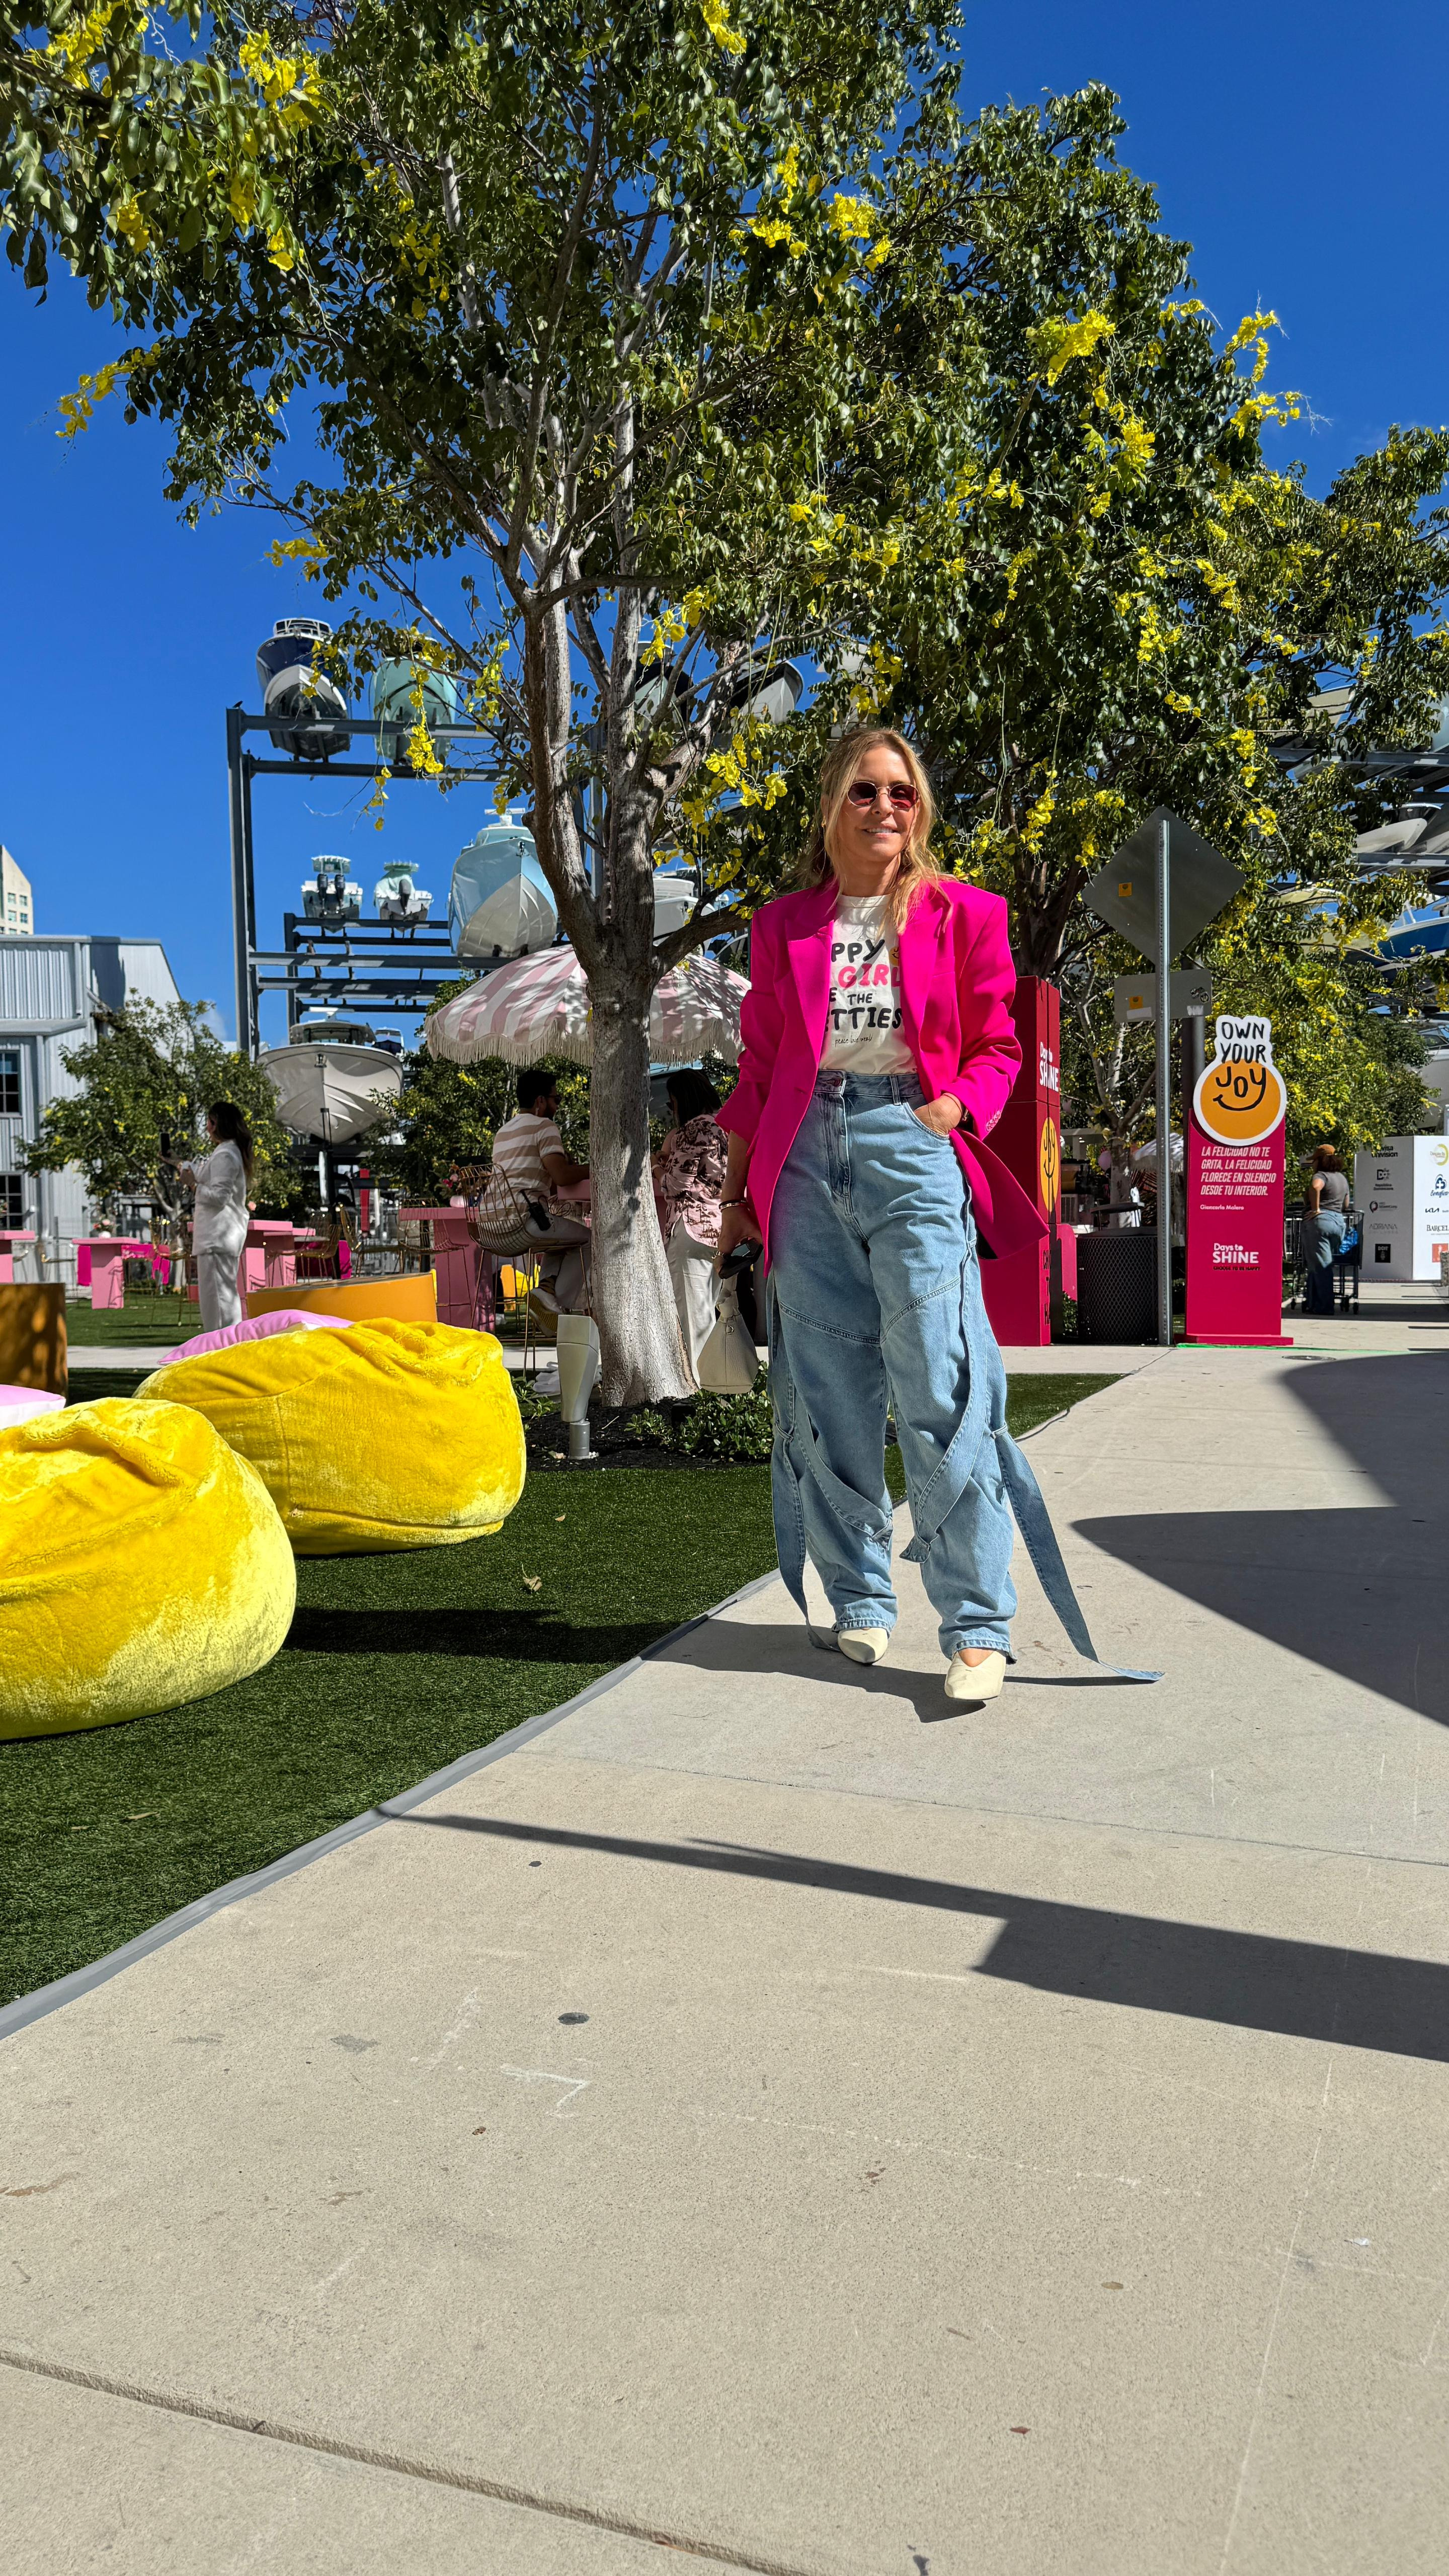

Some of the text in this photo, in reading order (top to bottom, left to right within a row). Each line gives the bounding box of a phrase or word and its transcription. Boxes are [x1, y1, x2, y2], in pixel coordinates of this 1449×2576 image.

[847, 993, 873, 1005] THE
[1221, 1022, 1265, 1040] OWN
[1220, 1043, 1266, 1064] YOUR
[1039, 1060, 1059, 1092] SHINE
[1201, 1147, 1270, 1157] LA FELICIDAD NO TE
[1201, 1159, 1272, 1170] GRITA, LA FELICIDAD
[1201, 1172, 1276, 1183] FLORECE EN SILENCIO
[1200, 1185, 1268, 1196] DESDE TU INTERIOR.
[1214, 1243, 1234, 1252] Days
[1213, 1251, 1259, 1263] SHINE
